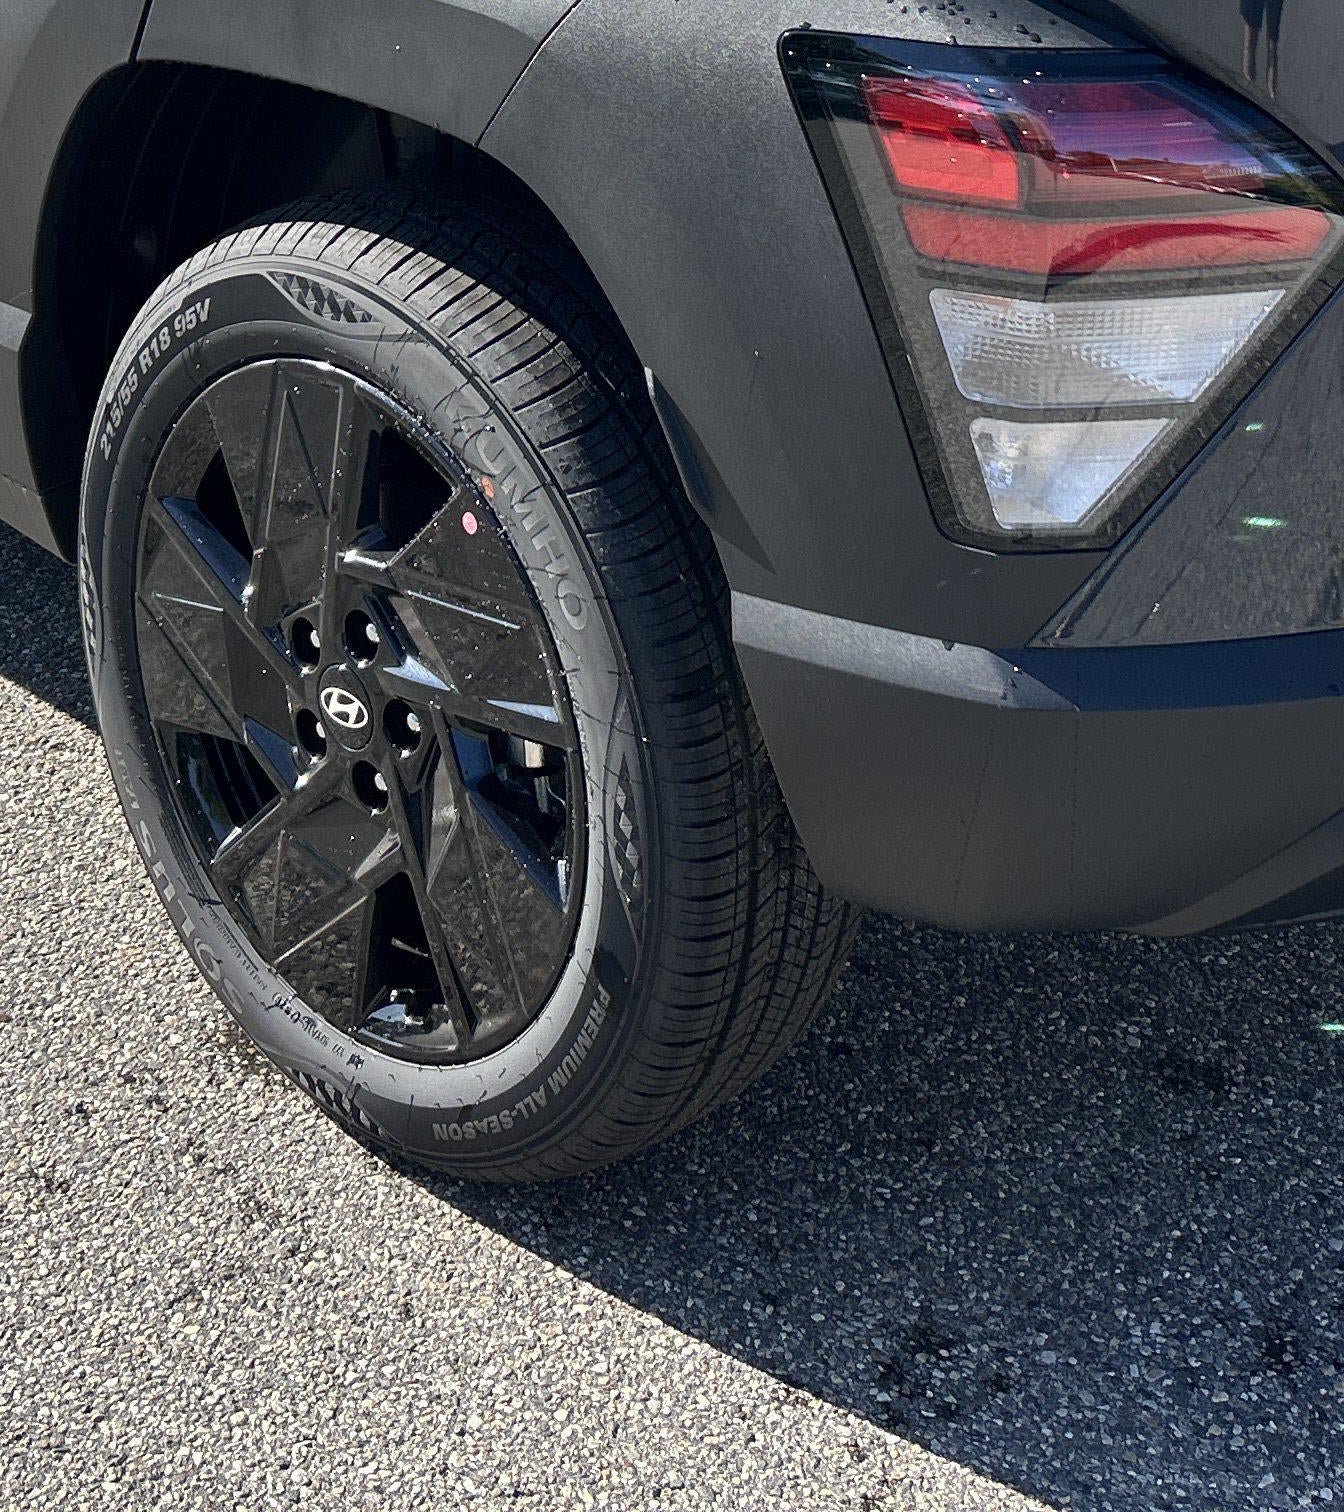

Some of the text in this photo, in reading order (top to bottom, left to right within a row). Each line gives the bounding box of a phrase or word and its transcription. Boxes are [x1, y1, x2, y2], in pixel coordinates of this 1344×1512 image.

[100, 297, 211, 461] 215/55 R18 95V
[444, 387, 589, 631] KUMHO
[134, 817, 245, 1016] SOLUS
[431, 983, 611, 1141] PREMIUM ALL-SEASON
